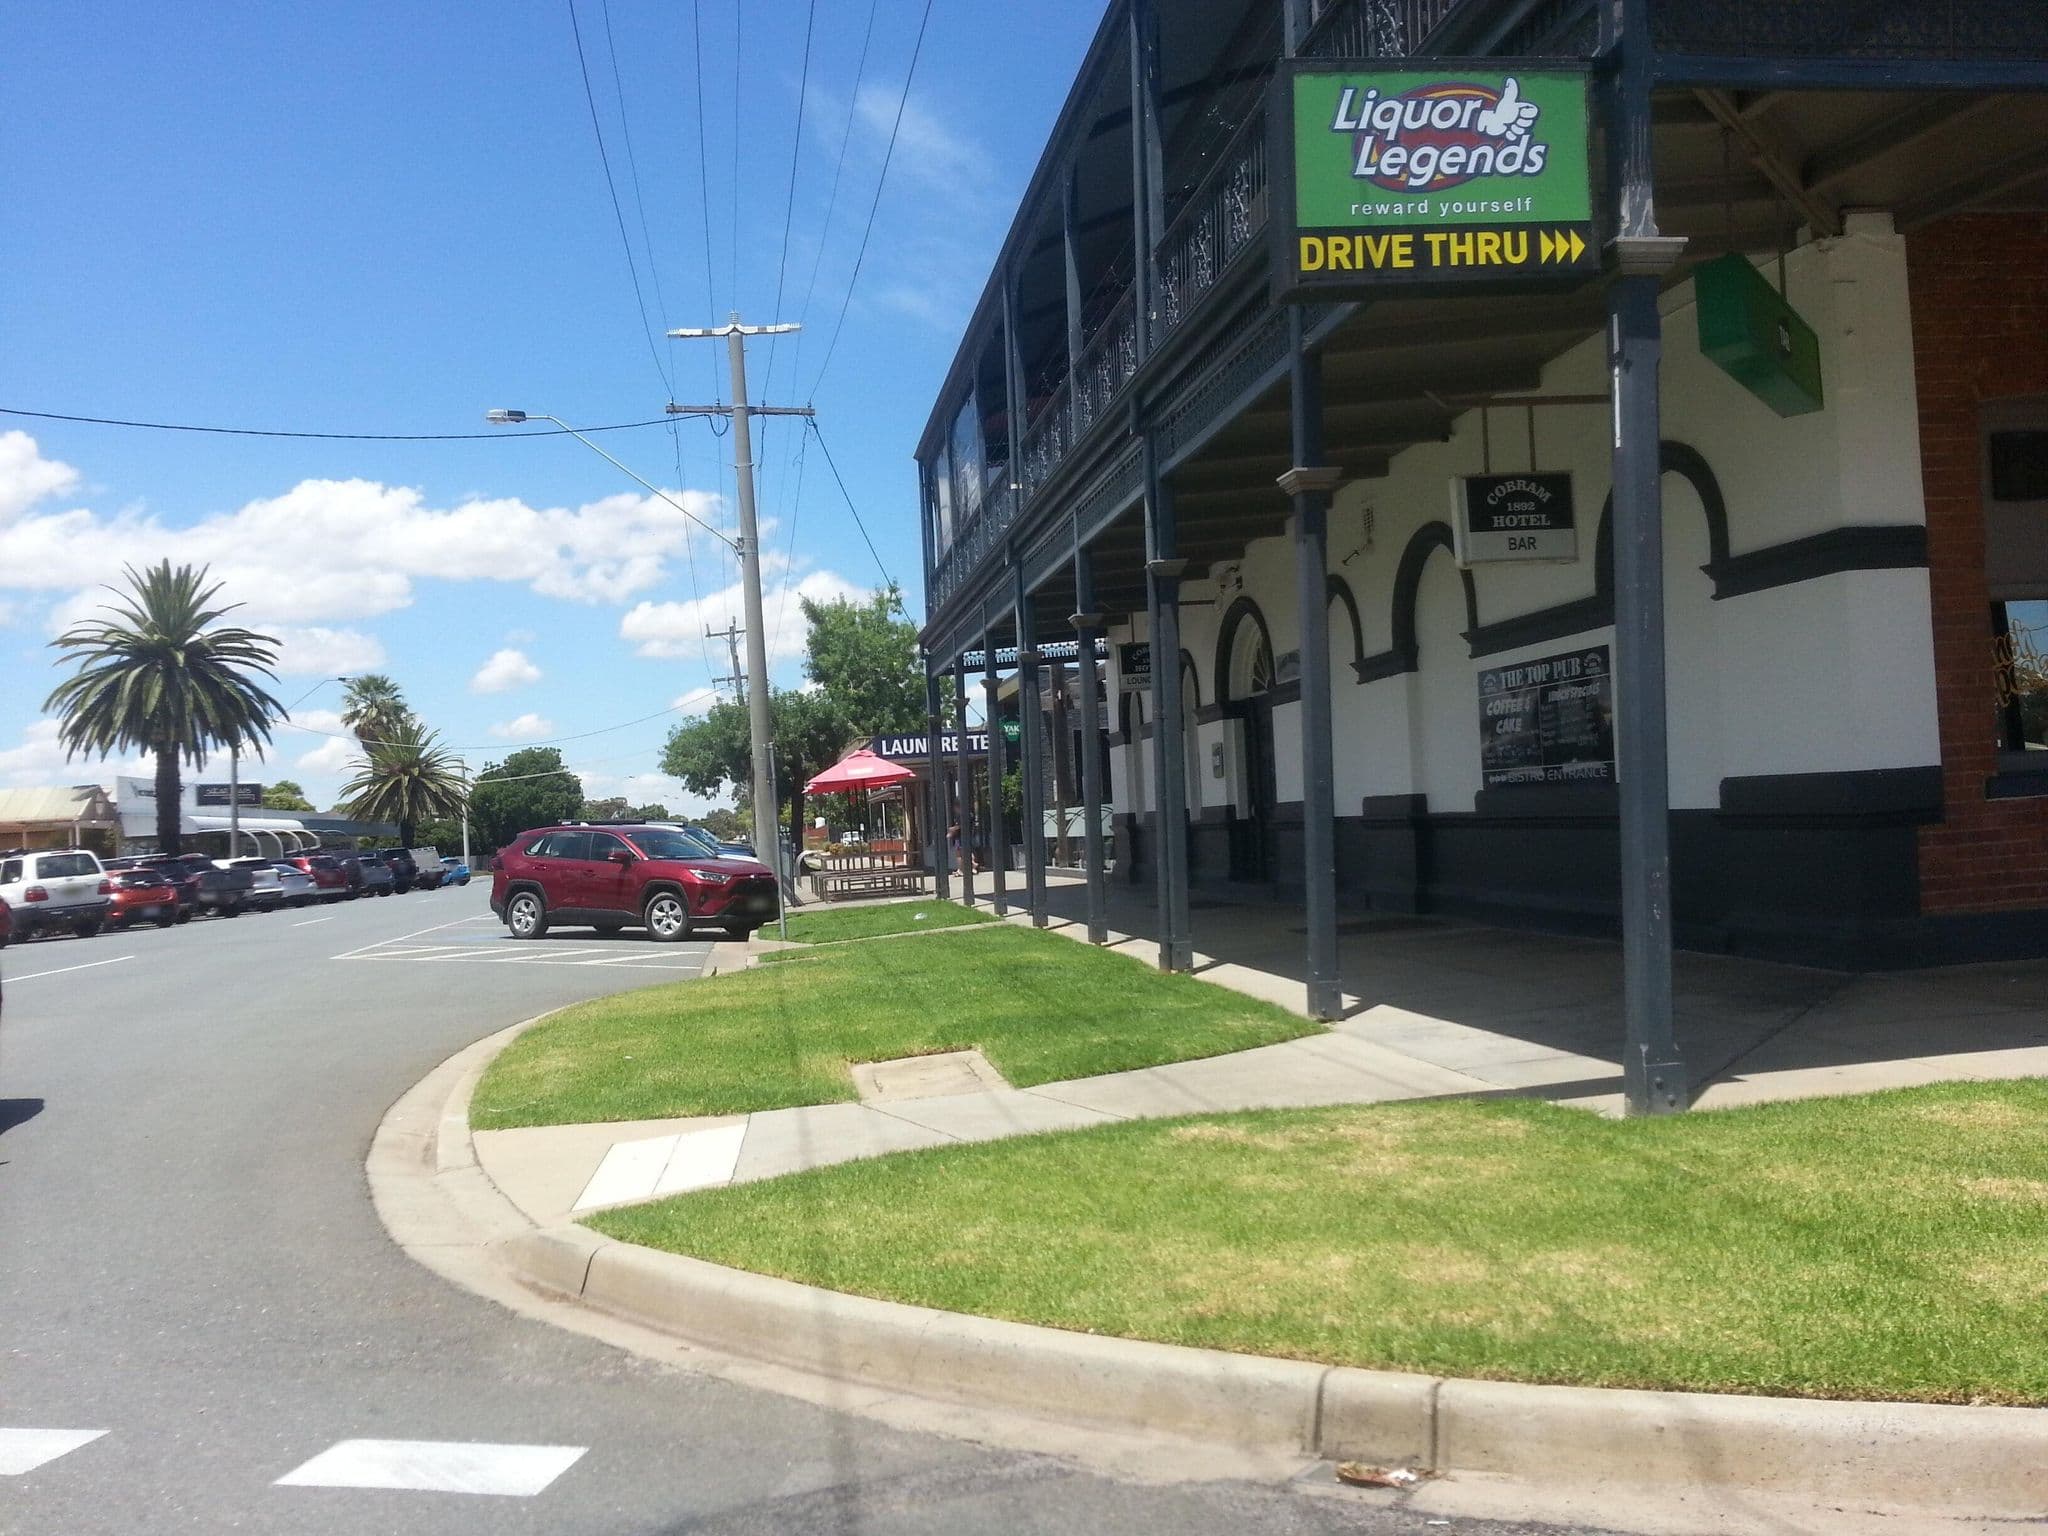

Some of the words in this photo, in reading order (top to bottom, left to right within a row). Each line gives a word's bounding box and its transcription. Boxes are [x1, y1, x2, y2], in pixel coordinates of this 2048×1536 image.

[1333, 88, 1482, 141] Liquor
[1354, 134, 1546, 186] Legends
[1351, 199, 1429, 216] reward
[1439, 198, 1533, 217] yourself
[1300, 234, 1414, 271] DRIVE
[1423, 230, 1528, 267] THRU
[1487, 480, 1552, 505] COBRAM
[1492, 514, 1551, 528] HOTEL
[1508, 536, 1537, 551] BAR
[1501, 669, 1523, 690] THE
[1526, 663, 1551, 684] TOP
[1553, 657, 1581, 679] PUB
[1547, 766, 1608, 780] ENTRANCE
